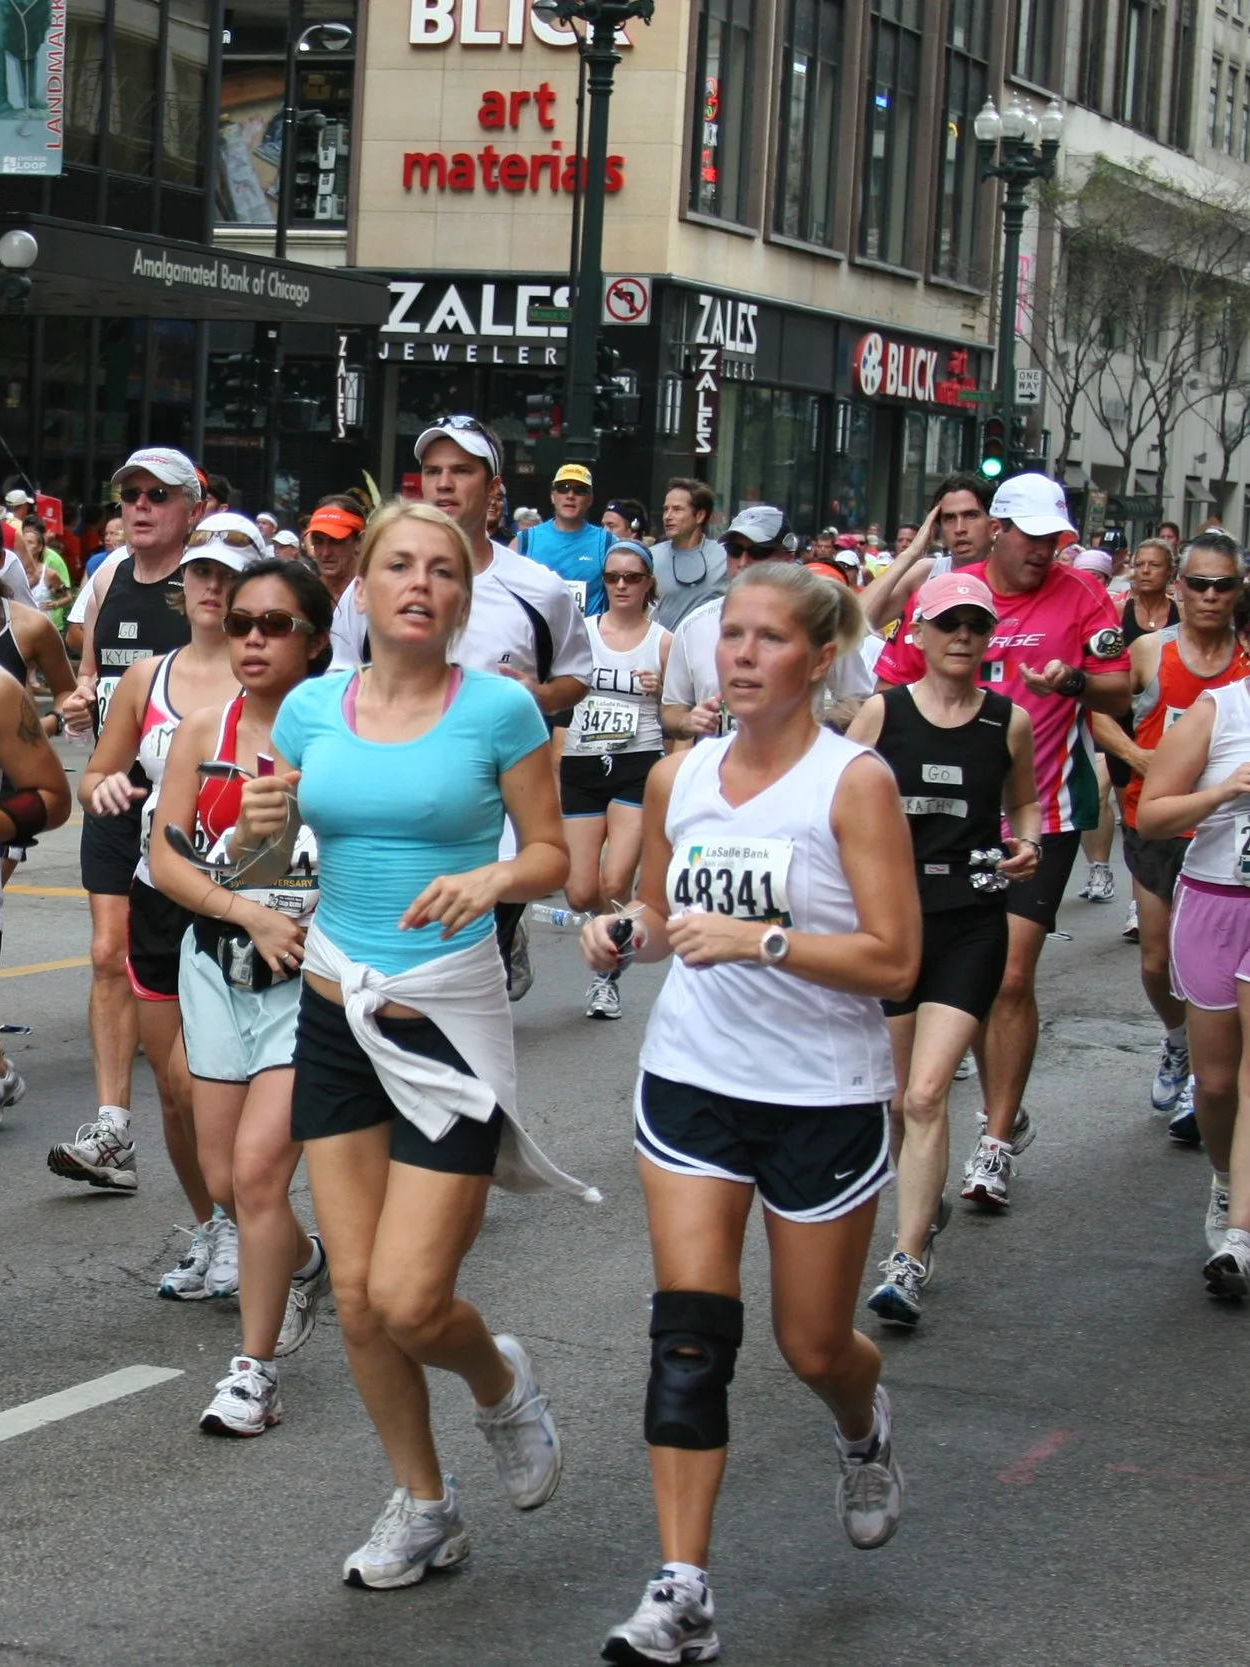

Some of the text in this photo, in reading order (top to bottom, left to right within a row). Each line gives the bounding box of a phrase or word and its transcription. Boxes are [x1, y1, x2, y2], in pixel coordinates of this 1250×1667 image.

[477, 82, 557, 128] art
[17, 161, 47, 169] LOOP
[402, 140, 625, 192] materias
[133, 249, 310, 307] Amalgamated Bank of Chicago
[695, 294, 759, 355] ZALES
[378, 342, 557, 365] JEWELER
[336, 335, 348, 438] ZALES
[885, 342, 939, 402] BLICK
[1018, 381, 1040, 391] WAY
[1019, 371, 1039, 381] ONE
[695, 348, 718, 453] ZALES
[119, 623, 137, 638] GO
[581, 710, 633, 732] 34753
[906, 799, 954, 813] KATHY
[705, 846, 770, 860] LaSalle Bank
[674, 867, 782, 916] 48341
